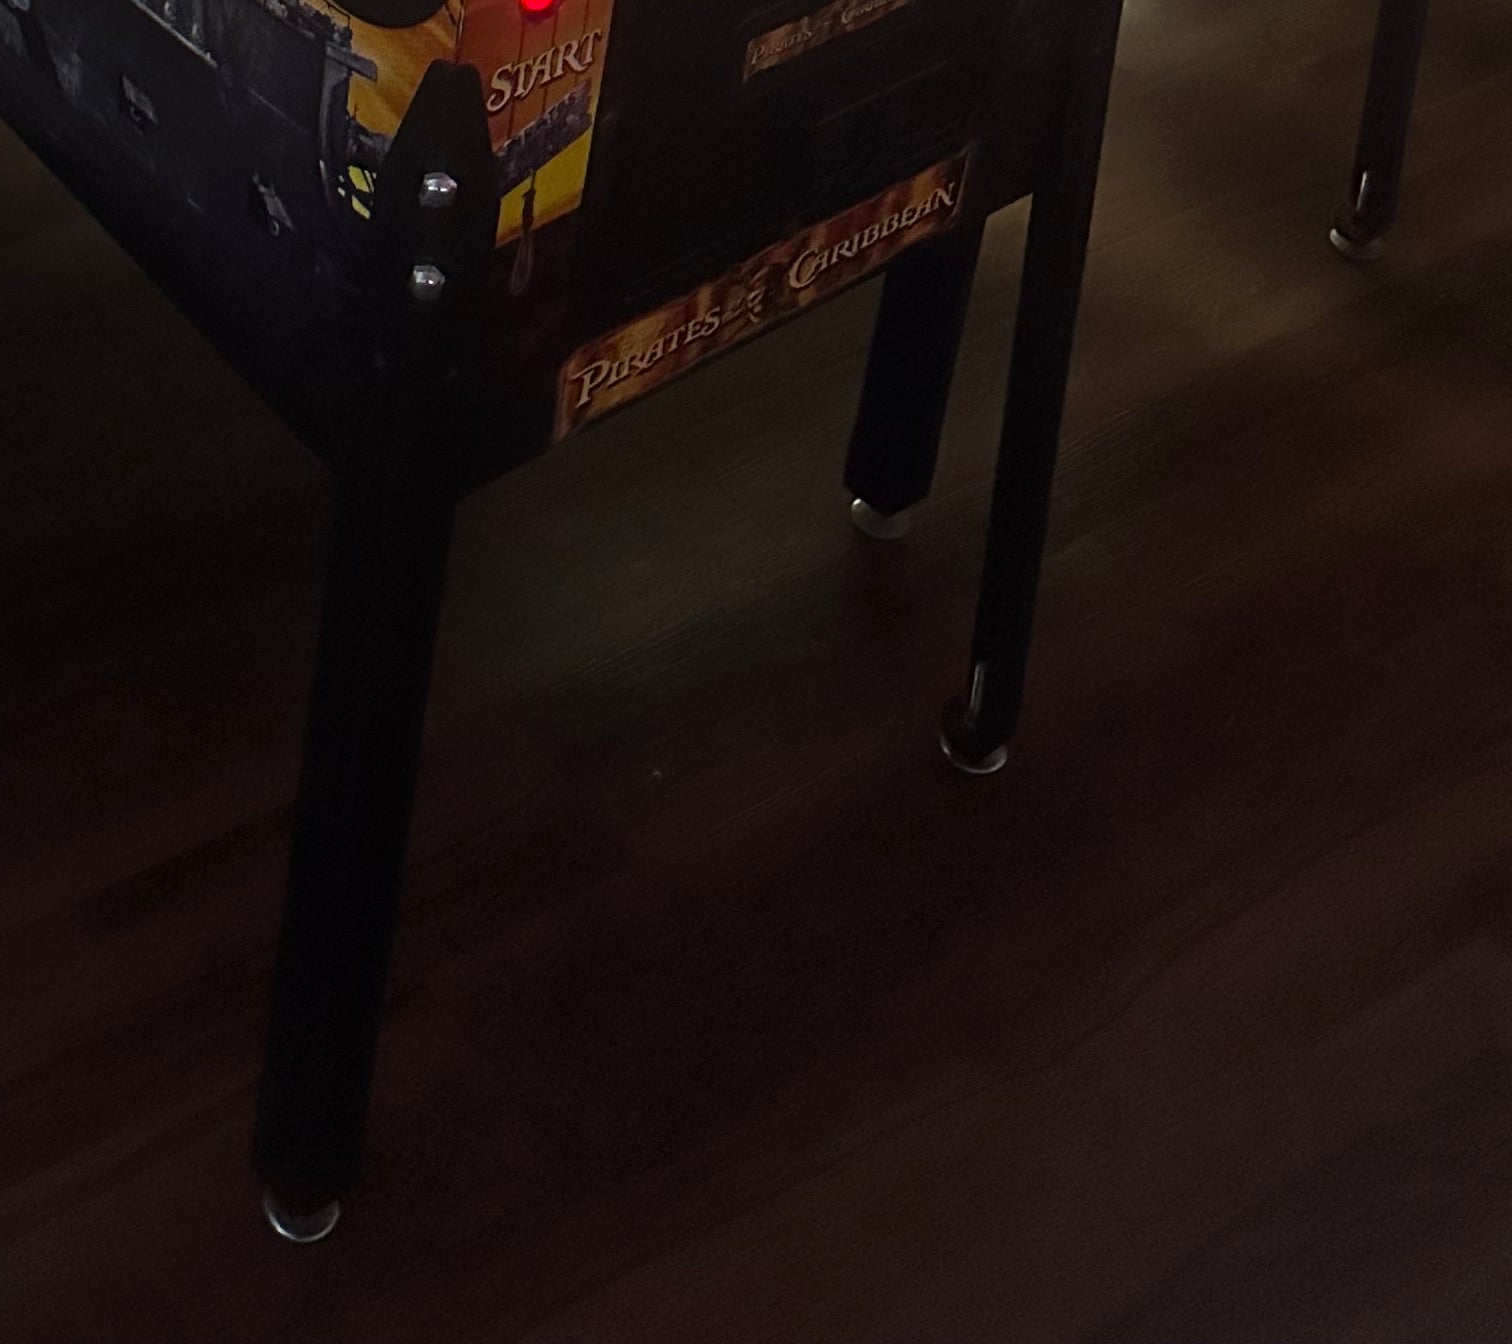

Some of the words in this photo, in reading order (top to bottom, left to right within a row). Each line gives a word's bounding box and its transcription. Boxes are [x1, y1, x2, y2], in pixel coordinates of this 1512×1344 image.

[486, 28, 602, 113] START
[570, 306, 720, 409] PIRATES
[787, 181, 956, 289] CARIBBEAN
